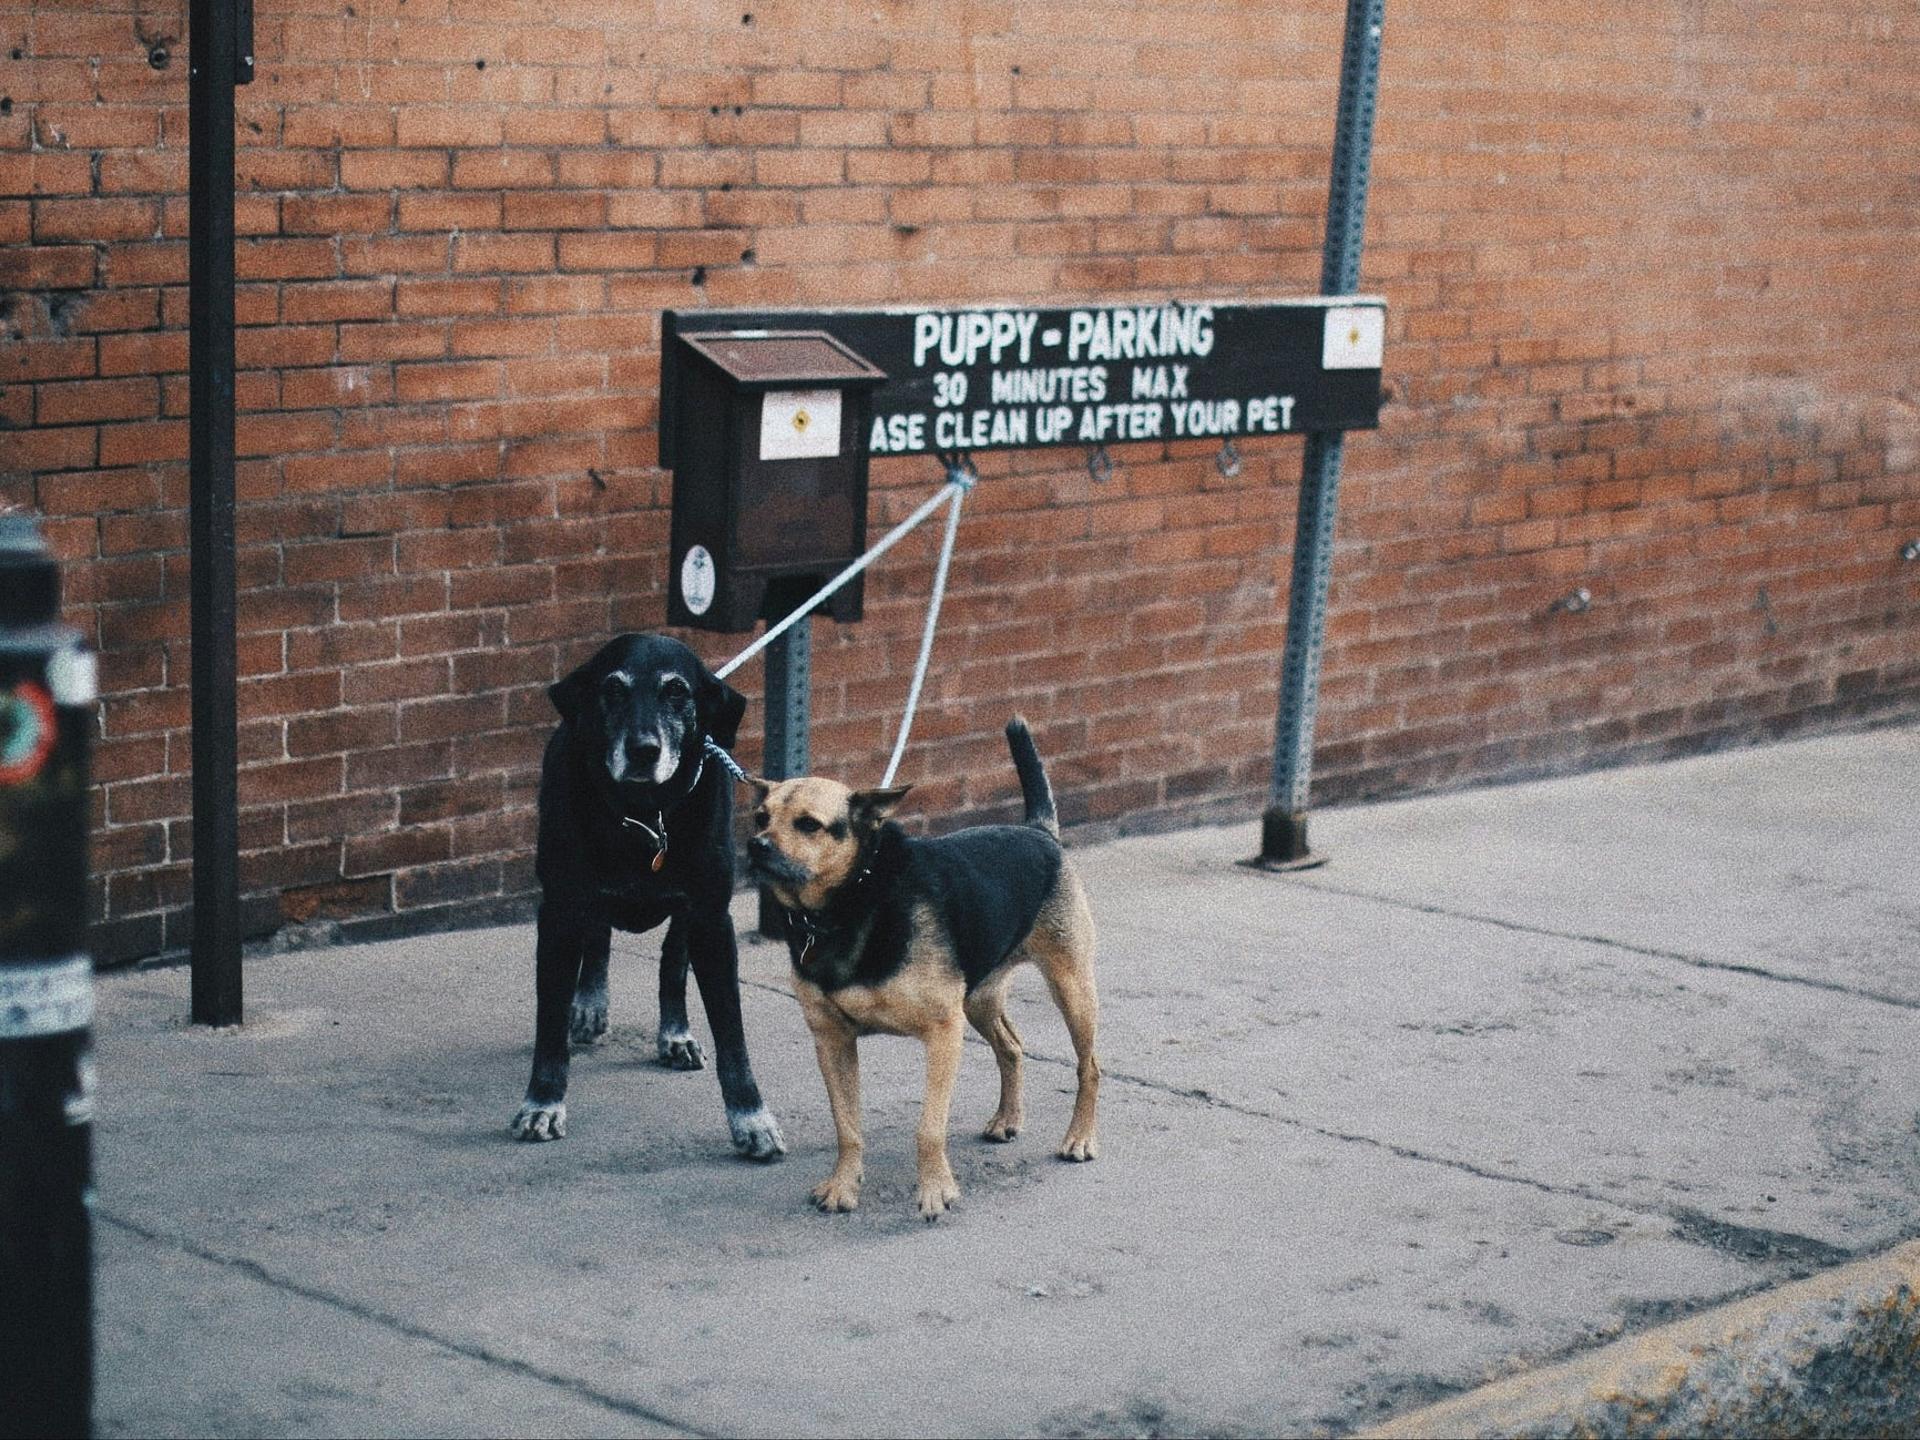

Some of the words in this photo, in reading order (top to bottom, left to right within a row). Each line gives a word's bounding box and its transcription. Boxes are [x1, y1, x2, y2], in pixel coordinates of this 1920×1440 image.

[913, 313, 1038, 367] PUPPY
[1068, 308, 1213, 360] PARKING
[933, 372, 968, 407] 30
[992, 367, 1107, 404] MINUTES
[1133, 365, 1189, 399] MAX
[936, 410, 1027, 448] CLEAN
[1035, 407, 1073, 442] UP
[1079, 403, 1162, 440] AFTER
[1170, 398, 1240, 434] YOUR
[1247, 396, 1295, 430] PET
